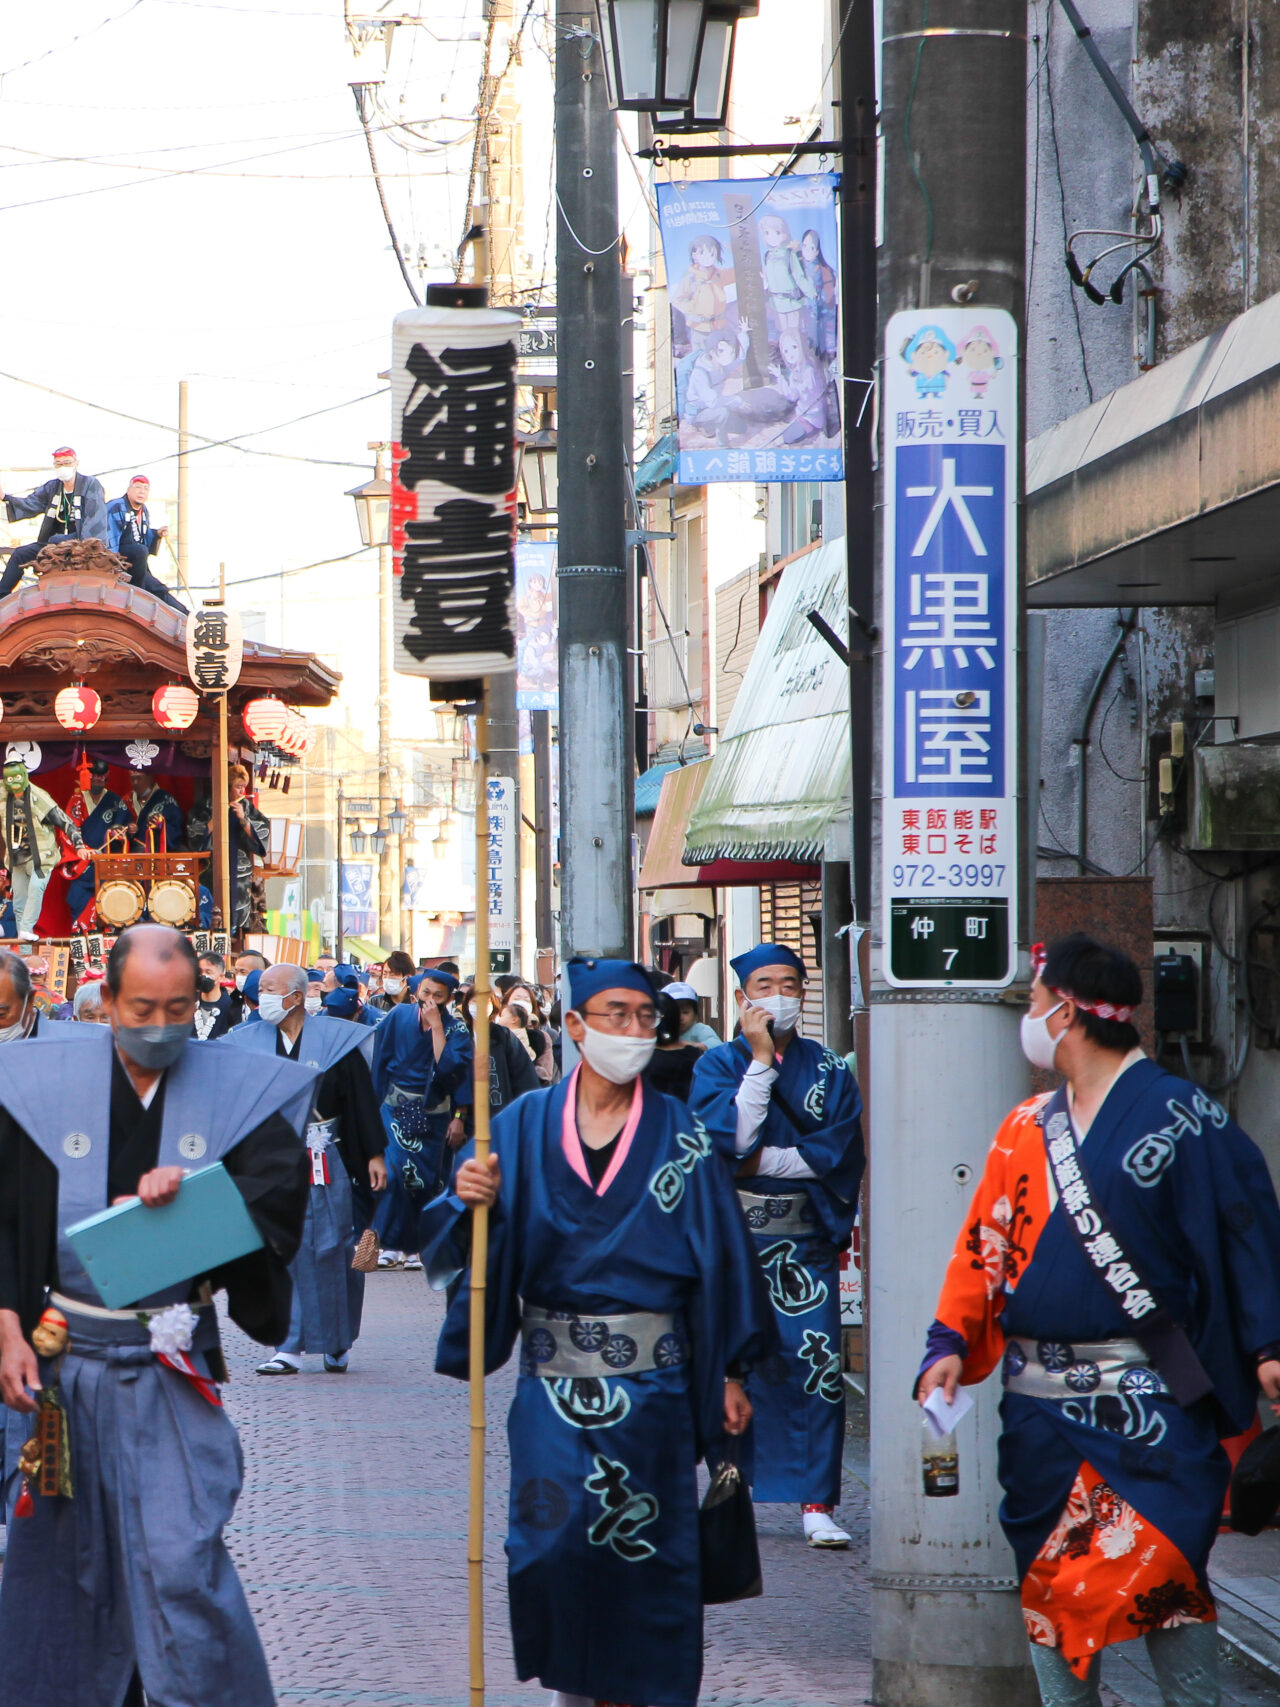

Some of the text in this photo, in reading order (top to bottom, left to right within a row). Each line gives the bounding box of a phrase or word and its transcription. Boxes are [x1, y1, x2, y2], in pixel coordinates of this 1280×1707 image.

[896, 409, 1005, 439] 販売・買入
[901, 458, 998, 784] 大黒屋
[901, 808, 998, 831] 東飯能駅
[901, 834, 998, 855] 東口そば
[893, 864, 1006, 887] 972-3997
[942, 948, 960, 970] 7
